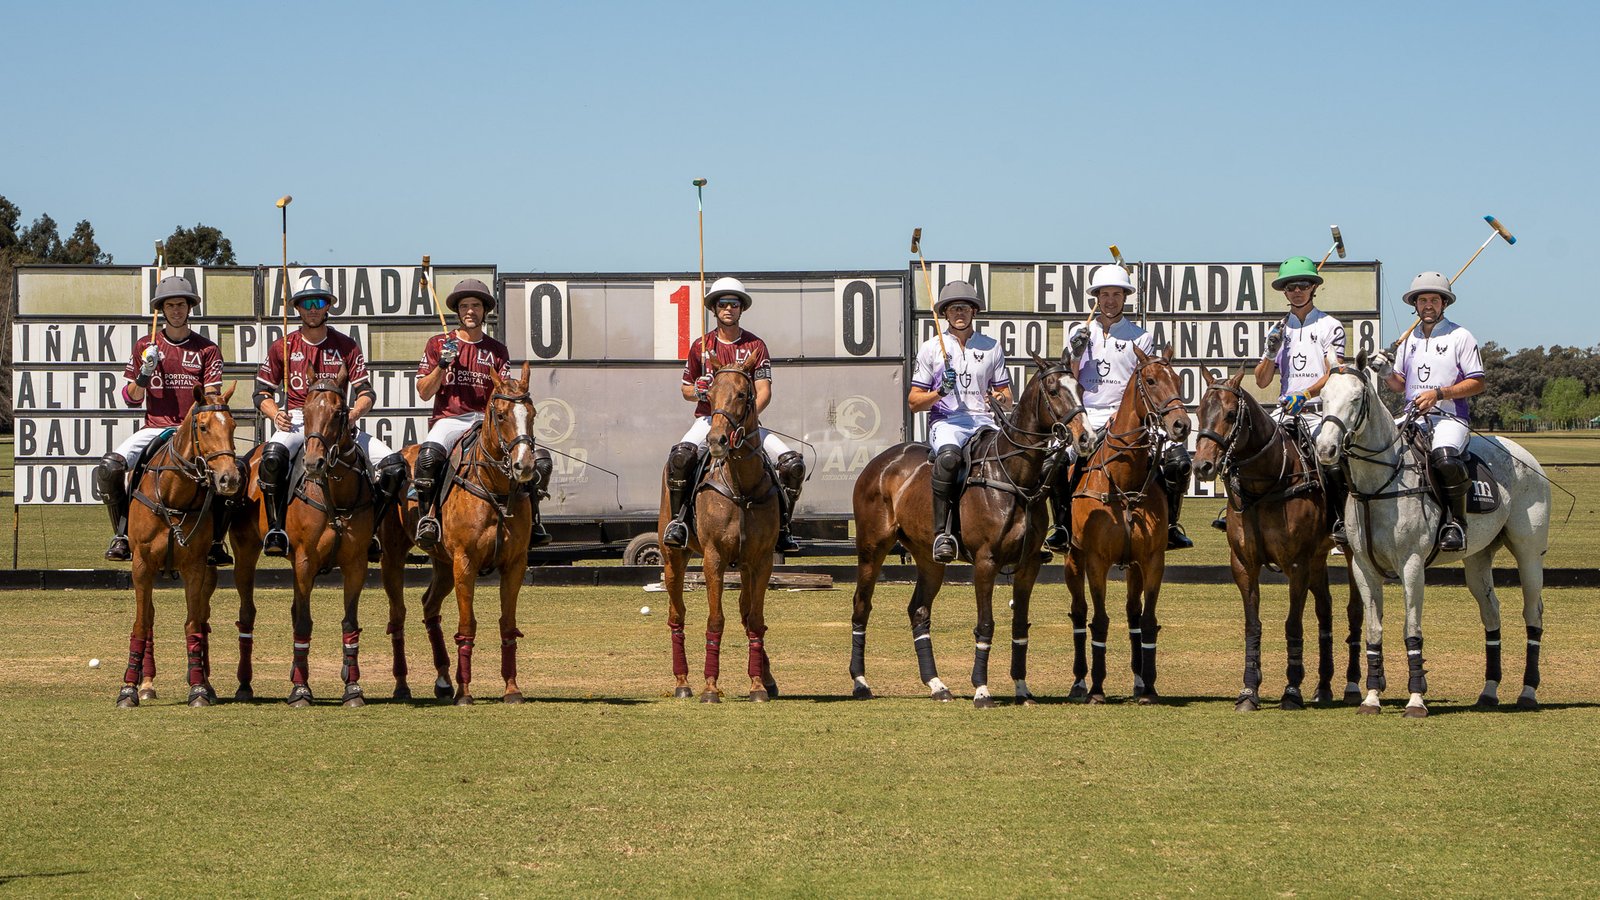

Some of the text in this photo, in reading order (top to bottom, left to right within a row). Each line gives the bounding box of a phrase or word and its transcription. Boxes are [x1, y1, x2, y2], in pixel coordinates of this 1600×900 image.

[272, 268, 432, 316] AUADA
[1038, 265, 1259, 313] ENNADA
[530, 283, 562, 359] 0
[670, 286, 690, 360] 1
[842, 281, 874, 356] 0
[1331, 326, 1345, 348] 2
[17, 372, 142, 409] ALFR
[165, 373, 199, 381] PORTOFINO
[457, 376, 484, 384] CAPITAL
[550, 448, 588, 475] AP
